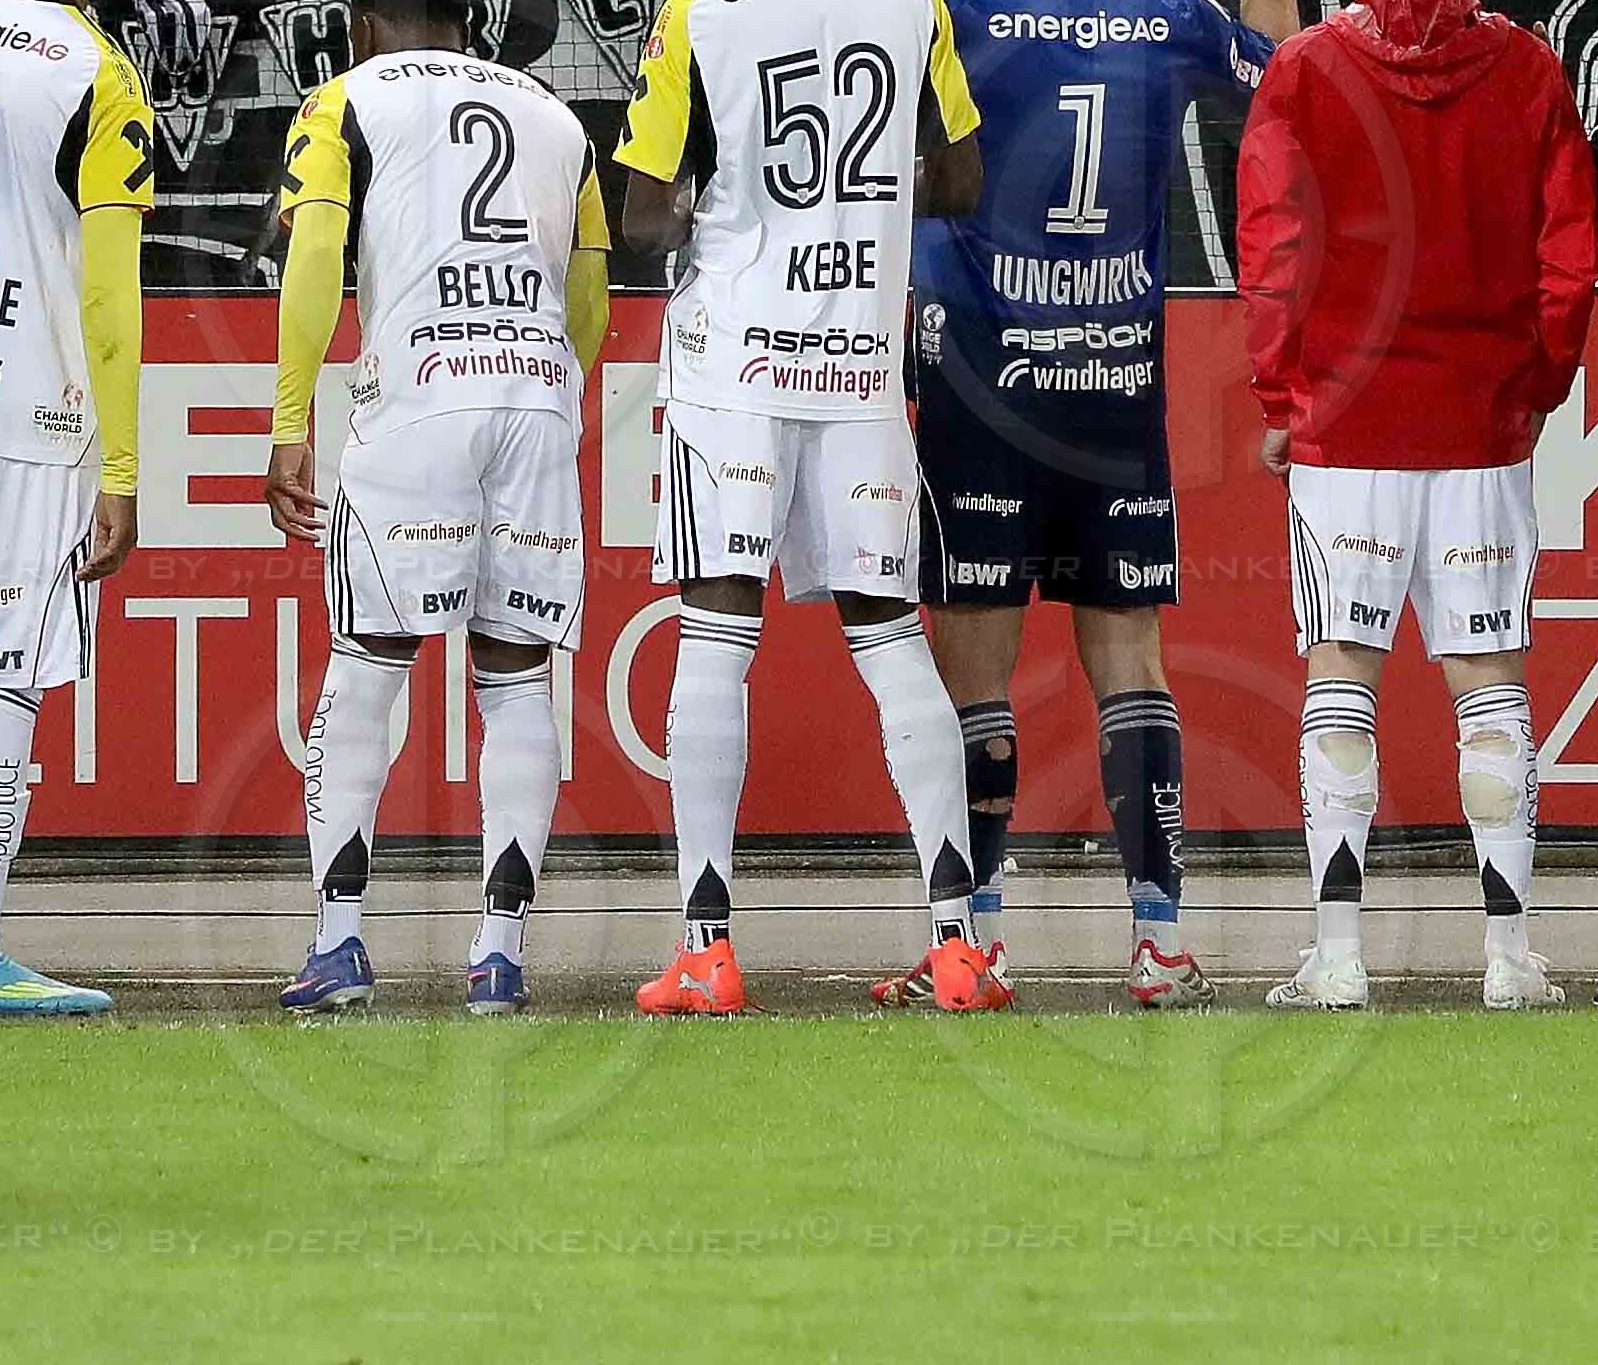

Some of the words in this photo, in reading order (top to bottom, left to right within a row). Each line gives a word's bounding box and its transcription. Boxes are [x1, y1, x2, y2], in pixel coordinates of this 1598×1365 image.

[757, 42, 899, 209] 52
[449, 100, 530, 243] 2
[1045, 83, 1110, 234] 1
[787, 240, 877, 293] KEBE
[438, 262, 543, 313] BELLO
[410, 319, 568, 350] ASPÖCK
[743, 326, 890, 356] ASPÖCK
[1001, 319, 1154, 351] ASPÖCK
[447, 348, 570, 390] windhager
[772, 361, 890, 401] windhager
[1032, 358, 1155, 397] windhager
[34, 407, 84, 424] CHANGE
[43, 421, 83, 435] WORLD
[957, 562, 1012, 588] BWT
[507, 588, 568, 623] BWT
[1349, 601, 1390, 629] BWT
[1468, 608, 1512, 634] BWT
